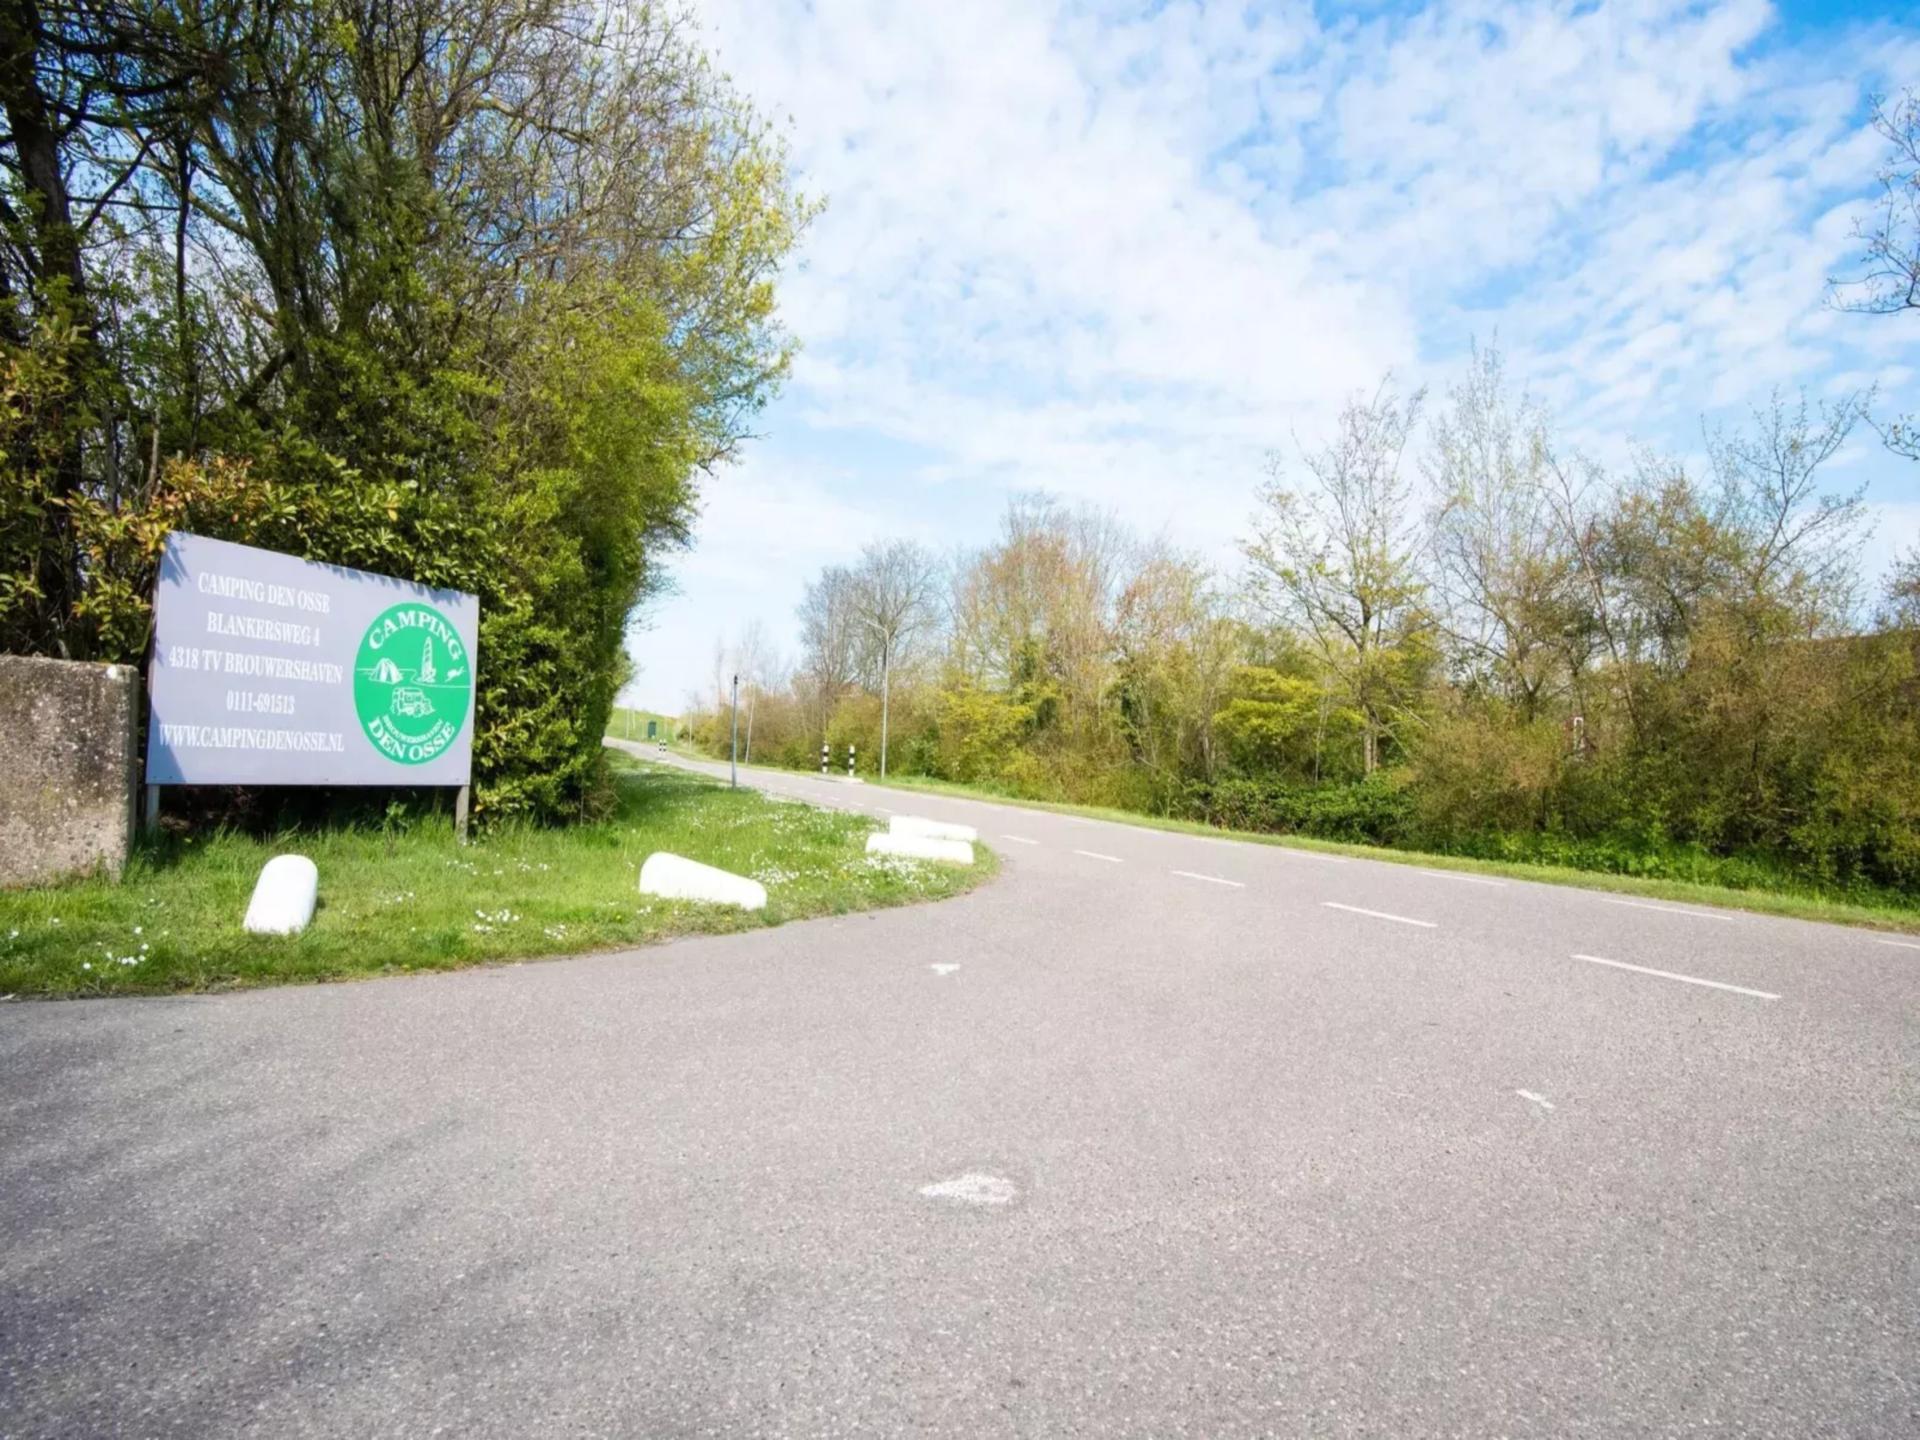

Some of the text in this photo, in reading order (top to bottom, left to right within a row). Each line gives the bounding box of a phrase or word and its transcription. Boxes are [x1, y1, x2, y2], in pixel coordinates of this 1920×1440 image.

[198, 572, 331, 613] CAMPING DEN OSSE
[207, 611, 320, 647] BLANKERSWEG 4
[369, 610, 462, 660] CAMPING
[168, 646, 343, 684] 4318 TV BROUWERSHAVEN
[159, 723, 345, 752] WWW.CAMPINGDENOSSE.NL
[368, 716, 406, 759] DEN
[409, 721, 455, 761] OSSE
